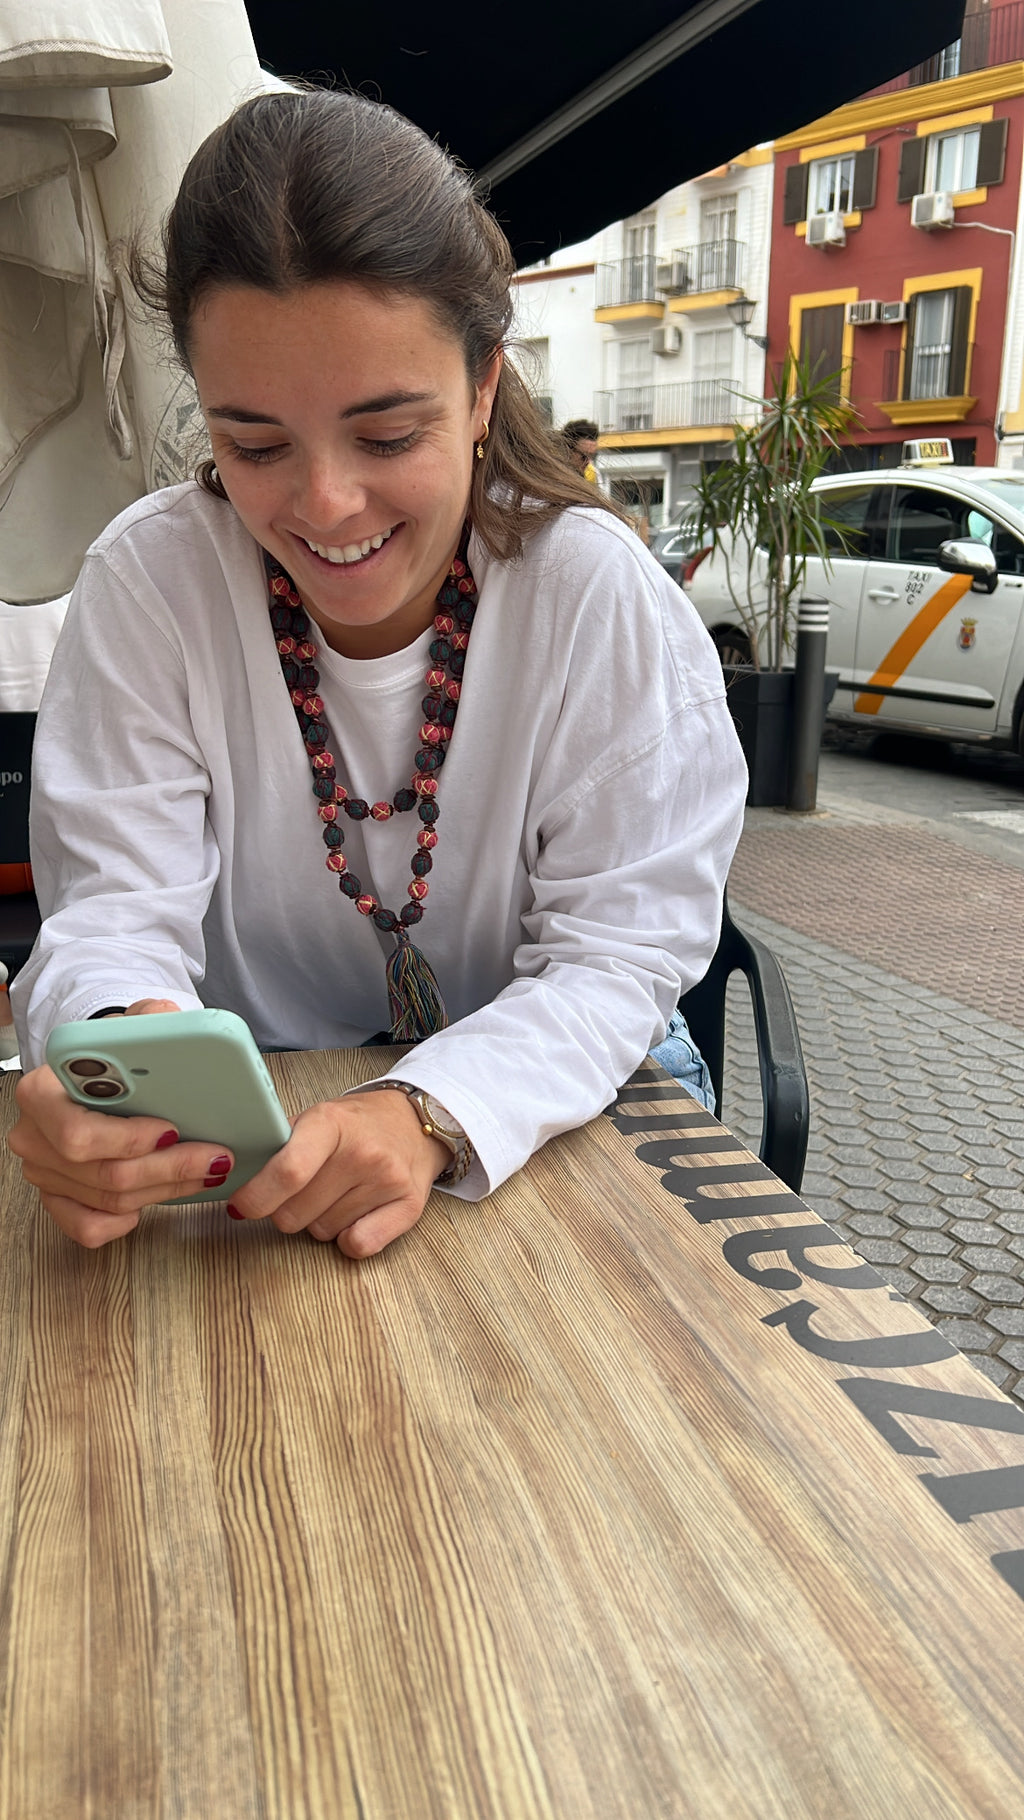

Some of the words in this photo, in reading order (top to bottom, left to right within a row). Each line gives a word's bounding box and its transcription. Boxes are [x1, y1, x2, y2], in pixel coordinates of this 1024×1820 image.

[919, 442, 943, 457] TAXI
[907, 571, 933, 582] TAXI
[0, 770, 23, 787] po
